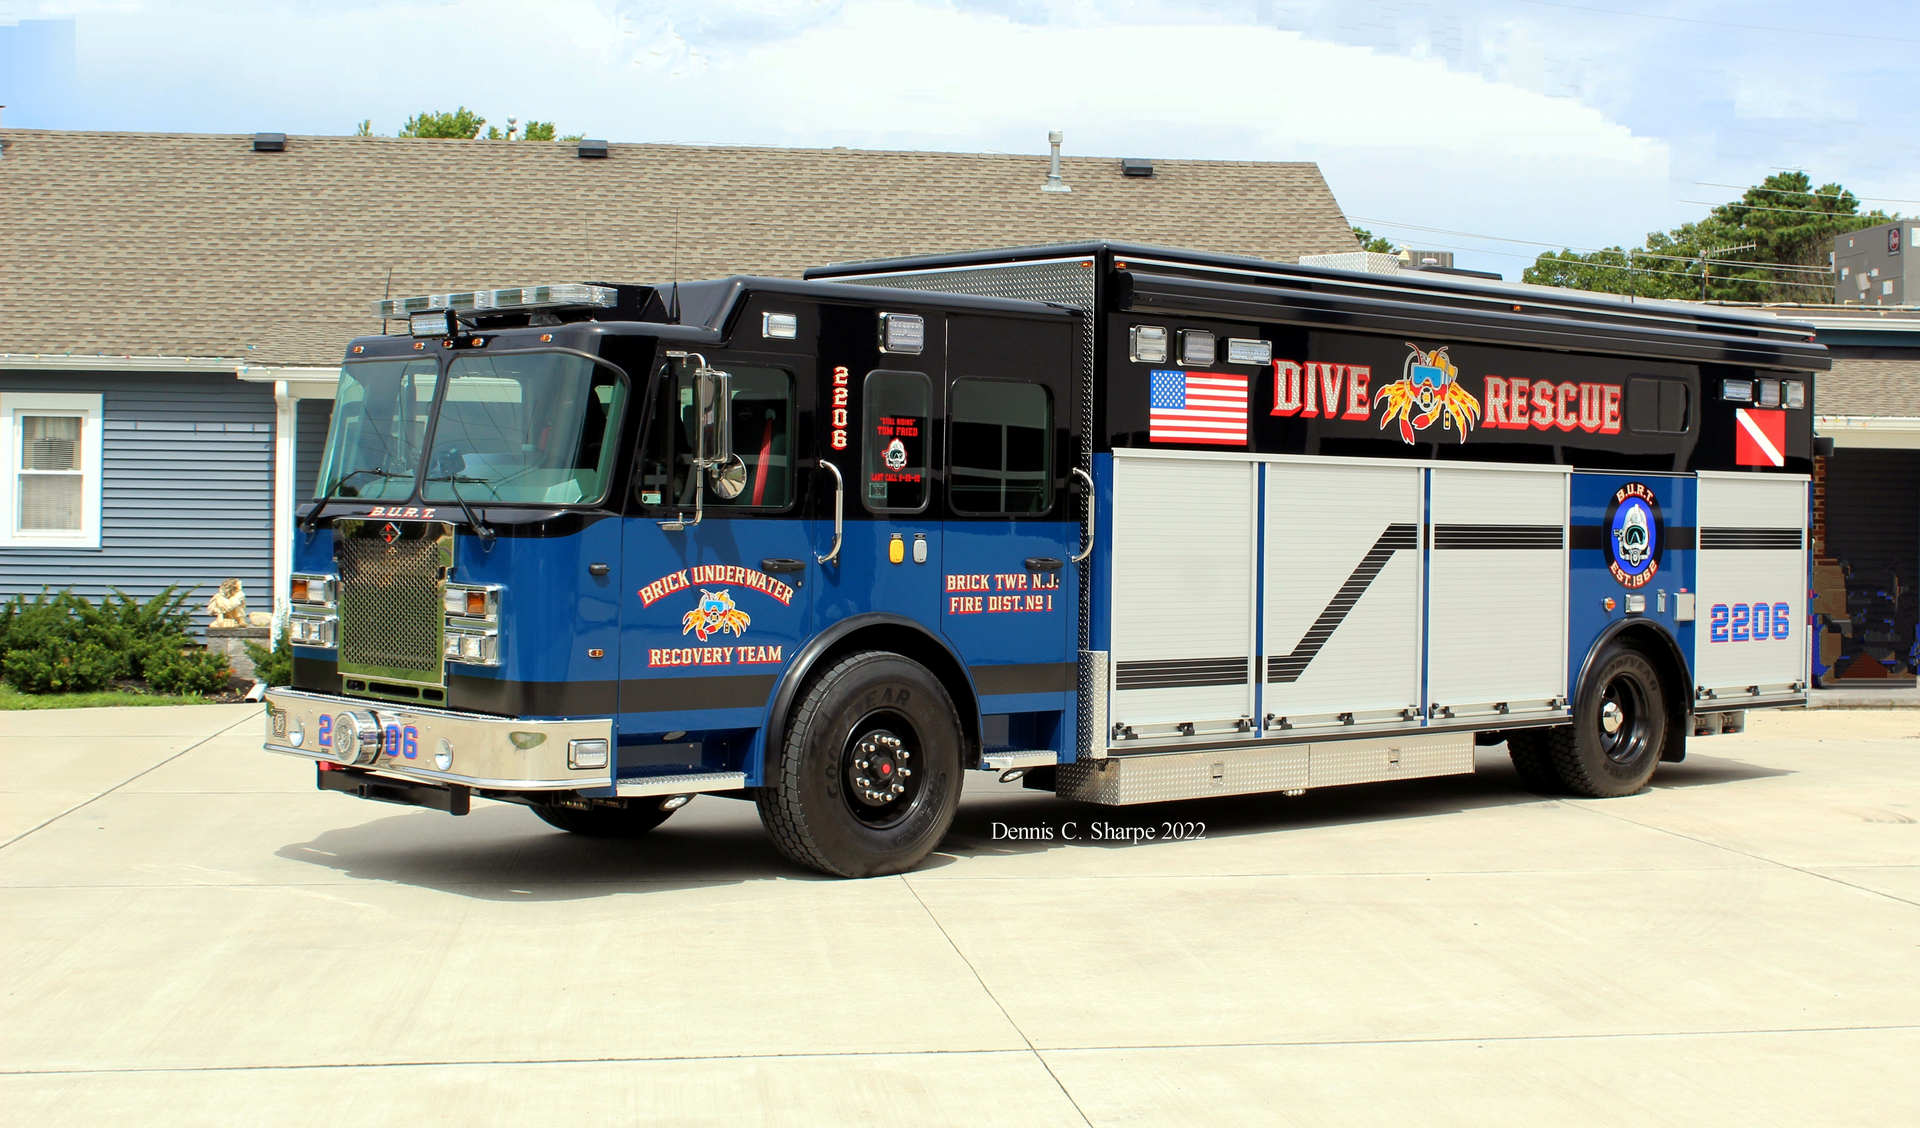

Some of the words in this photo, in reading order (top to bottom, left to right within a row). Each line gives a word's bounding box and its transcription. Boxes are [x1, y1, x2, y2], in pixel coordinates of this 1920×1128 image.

[831, 366, 849, 450] 2206
[1270, 359, 1372, 420] DIVE
[1482, 375, 1622, 435] RESCUE
[877, 426, 893, 435] TOM
[896, 427, 918, 436] FRIED
[871, 473, 885, 481] LAST
[885, 473, 897, 481] CALL
[1616, 483, 1654, 505] B.U.R.T.
[367, 506, 436, 519] B.U.R.T.
[637, 569, 691, 609] BRICK
[691, 564, 794, 606] UNDERWATER
[945, 574, 990, 592] BRICK
[994, 574, 1028, 591] TWP.
[949, 596, 983, 614] FIRE
[1710, 601, 1790, 644] 2206
[647, 646, 735, 667] RECOVERY
[736, 645, 783, 664] TEAM
[318, 713, 419, 760] 206
[825, 687, 911, 799] GOOYEAR
